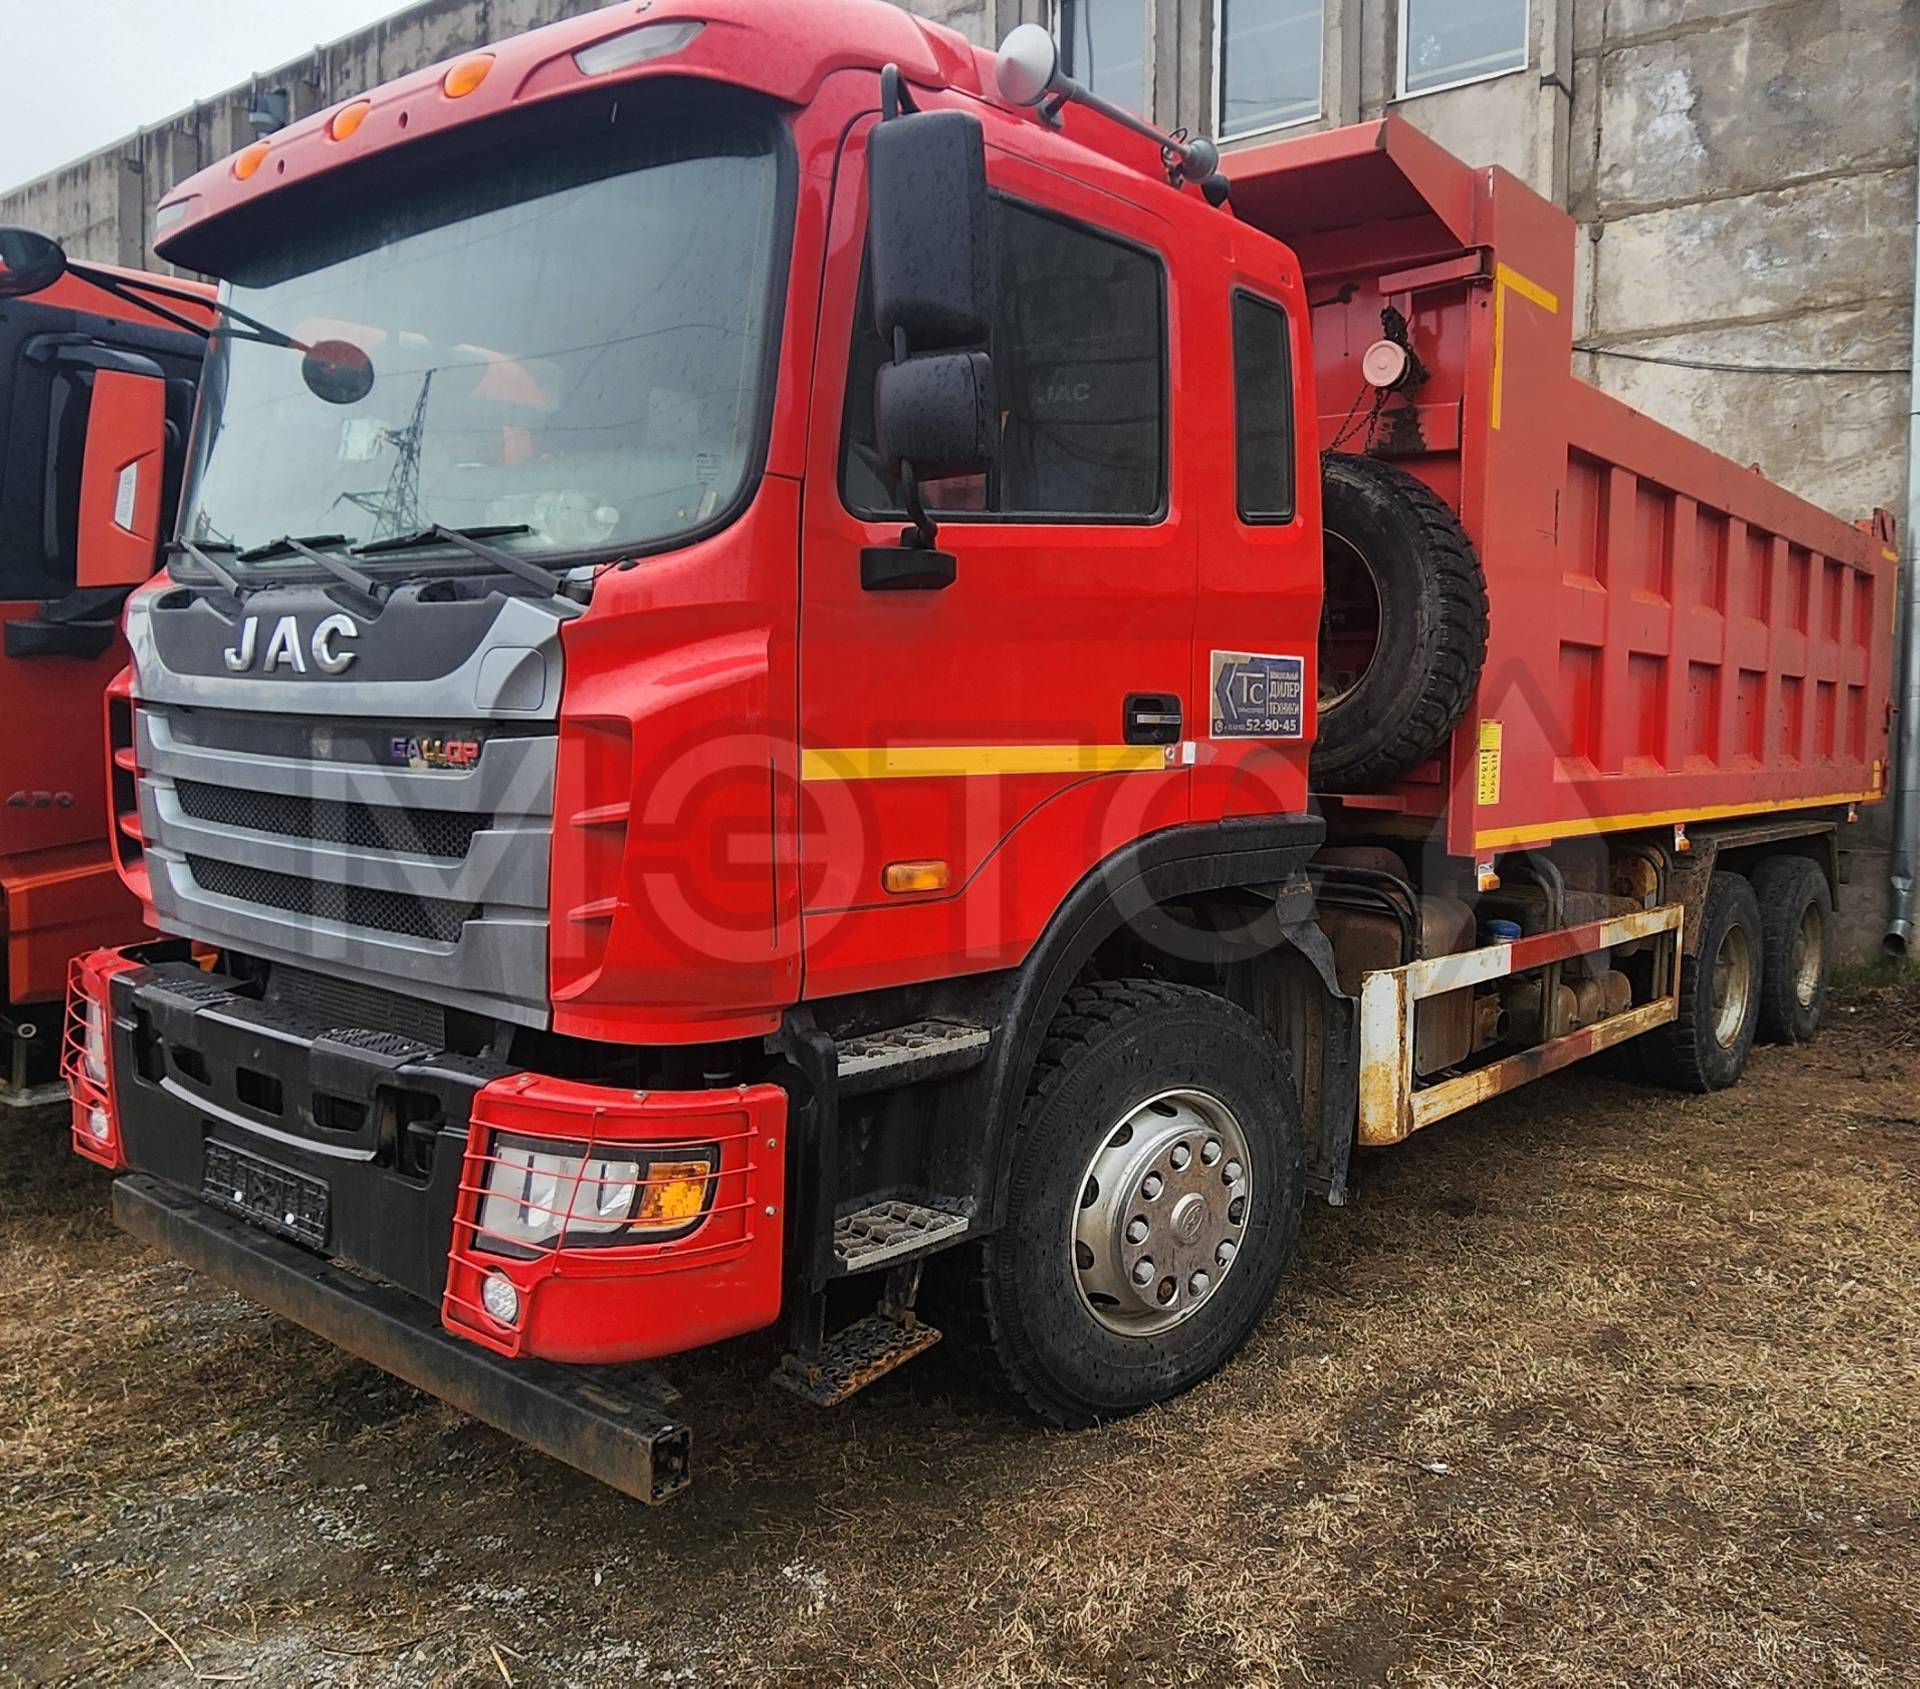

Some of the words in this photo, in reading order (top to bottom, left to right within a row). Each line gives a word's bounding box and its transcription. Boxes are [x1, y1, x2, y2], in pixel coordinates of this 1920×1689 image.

[223, 613, 359, 674] JAC
[1270, 681, 1300, 699] ДИЛЕР
[1246, 719, 1297, 731] 52-90-45
[391, 737, 479, 763] GALLOP
